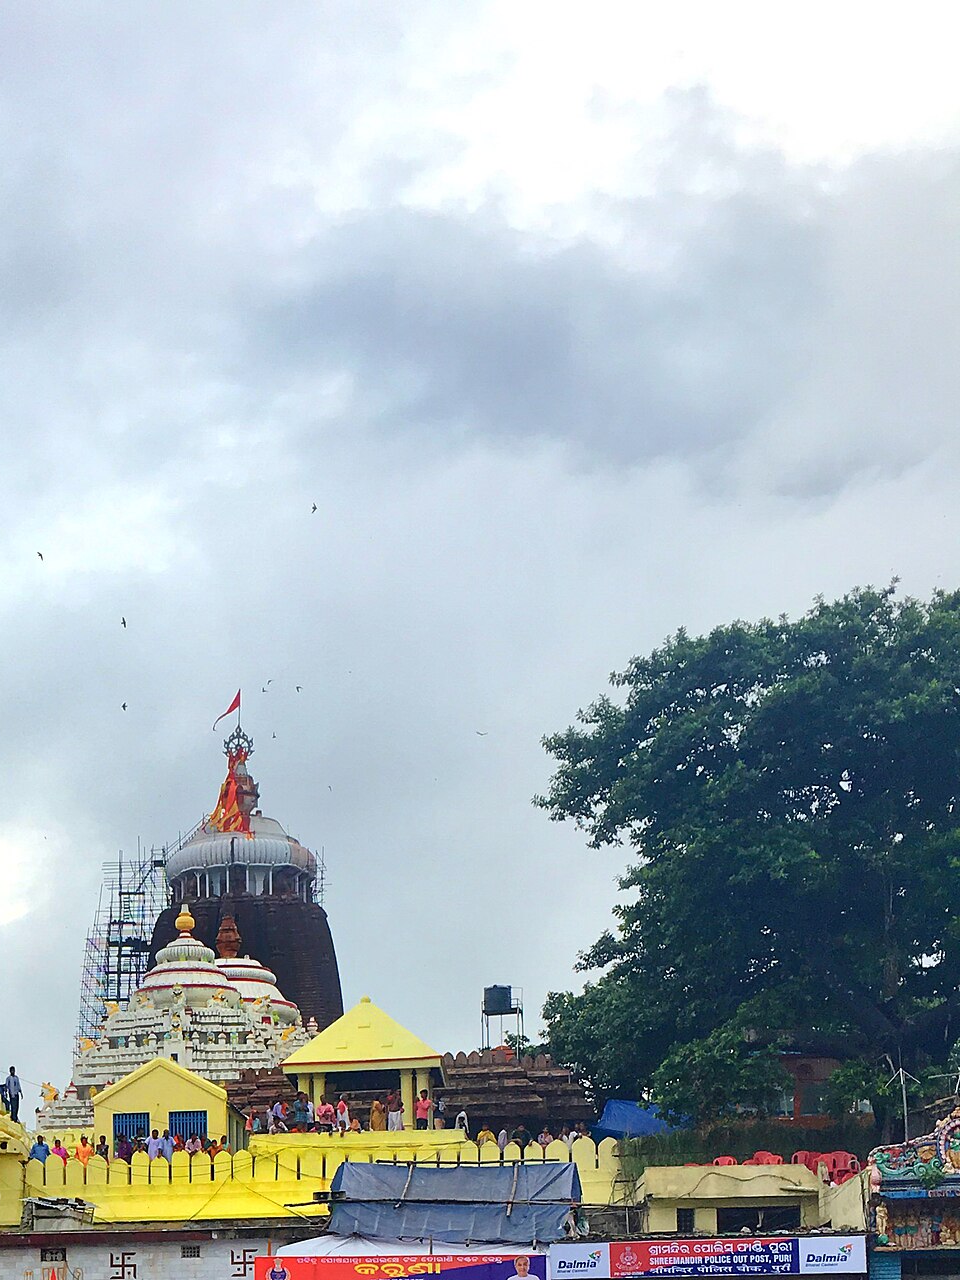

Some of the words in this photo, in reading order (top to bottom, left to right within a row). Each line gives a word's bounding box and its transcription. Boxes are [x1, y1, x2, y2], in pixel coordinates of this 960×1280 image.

[648, 1242, 690, 1255] ଶ୍ରୀମନ୍ଦିର
[693, 1241, 734, 1254] ପୋଲିସ୍
[769, 1241, 793, 1253] ପୁରୀ
[649, 1256, 703, 1265] SHREEMANDIR
[704, 1255, 731, 1264] POLICE
[733, 1255, 748, 1263] OUT
[750, 1254, 772, 1264] POST,
[774, 1253, 793, 1262] PURI
[806, 1253, 848, 1263] Dalmia
[354, 1262, 441, 1277] କରୁଣା
[558, 1260, 597, 1269] Dalmia
